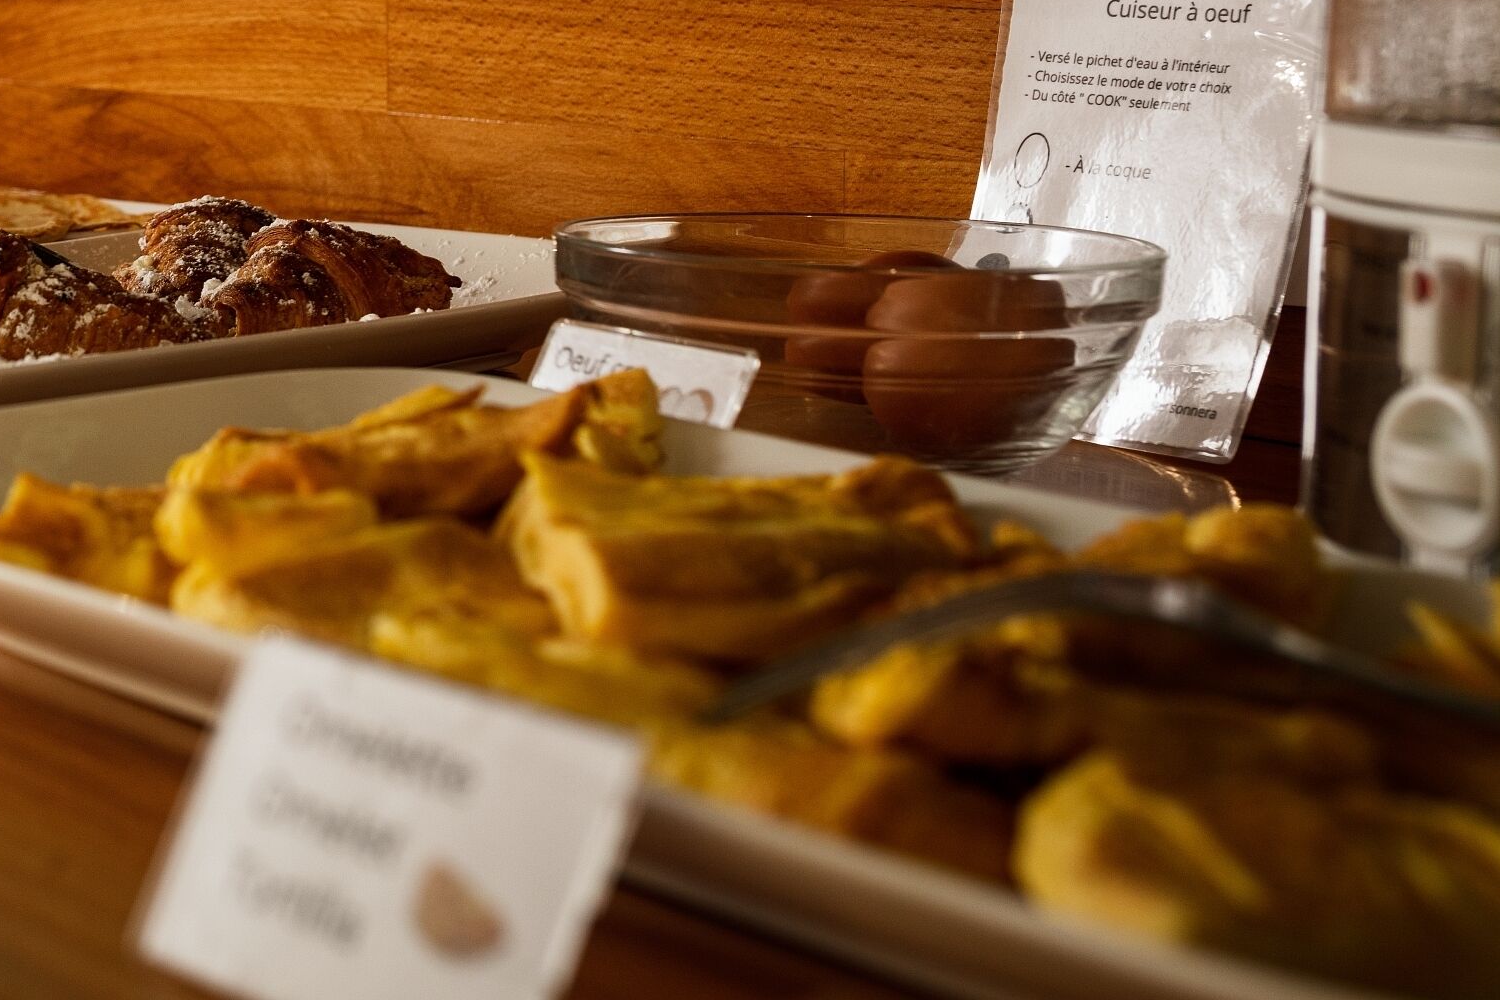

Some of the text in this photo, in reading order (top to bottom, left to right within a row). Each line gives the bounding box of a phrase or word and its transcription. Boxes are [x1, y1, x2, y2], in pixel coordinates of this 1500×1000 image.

[1106, 0, 1252, 23] Cuiseur à oeuf
[1038, 50, 1070, 64] Versé
[1073, 52, 1084, 65] le
[1086, 54, 1123, 68] pichet
[1126, 56, 1158, 70] d'eau
[1161, 59, 1169, 70] à
[1172, 59, 1230, 74] l'intérieur
[1035, 70, 1094, 86] Choisissez
[1098, 74, 1107, 86] le
[1111, 76, 1145, 89] mode
[1148, 78, 1163, 90] de
[1166, 81, 1196, 92] votre
[1199, 81, 1232, 94] choix
[1032, 89, 1048, 101] Du
[1051, 91, 1076, 104] côté
[1129, 98, 1191, 112] seulement
[1074, 155, 1084, 173] À
[1088, 162, 1101, 175] la
[1105, 163, 1152, 182] coque
